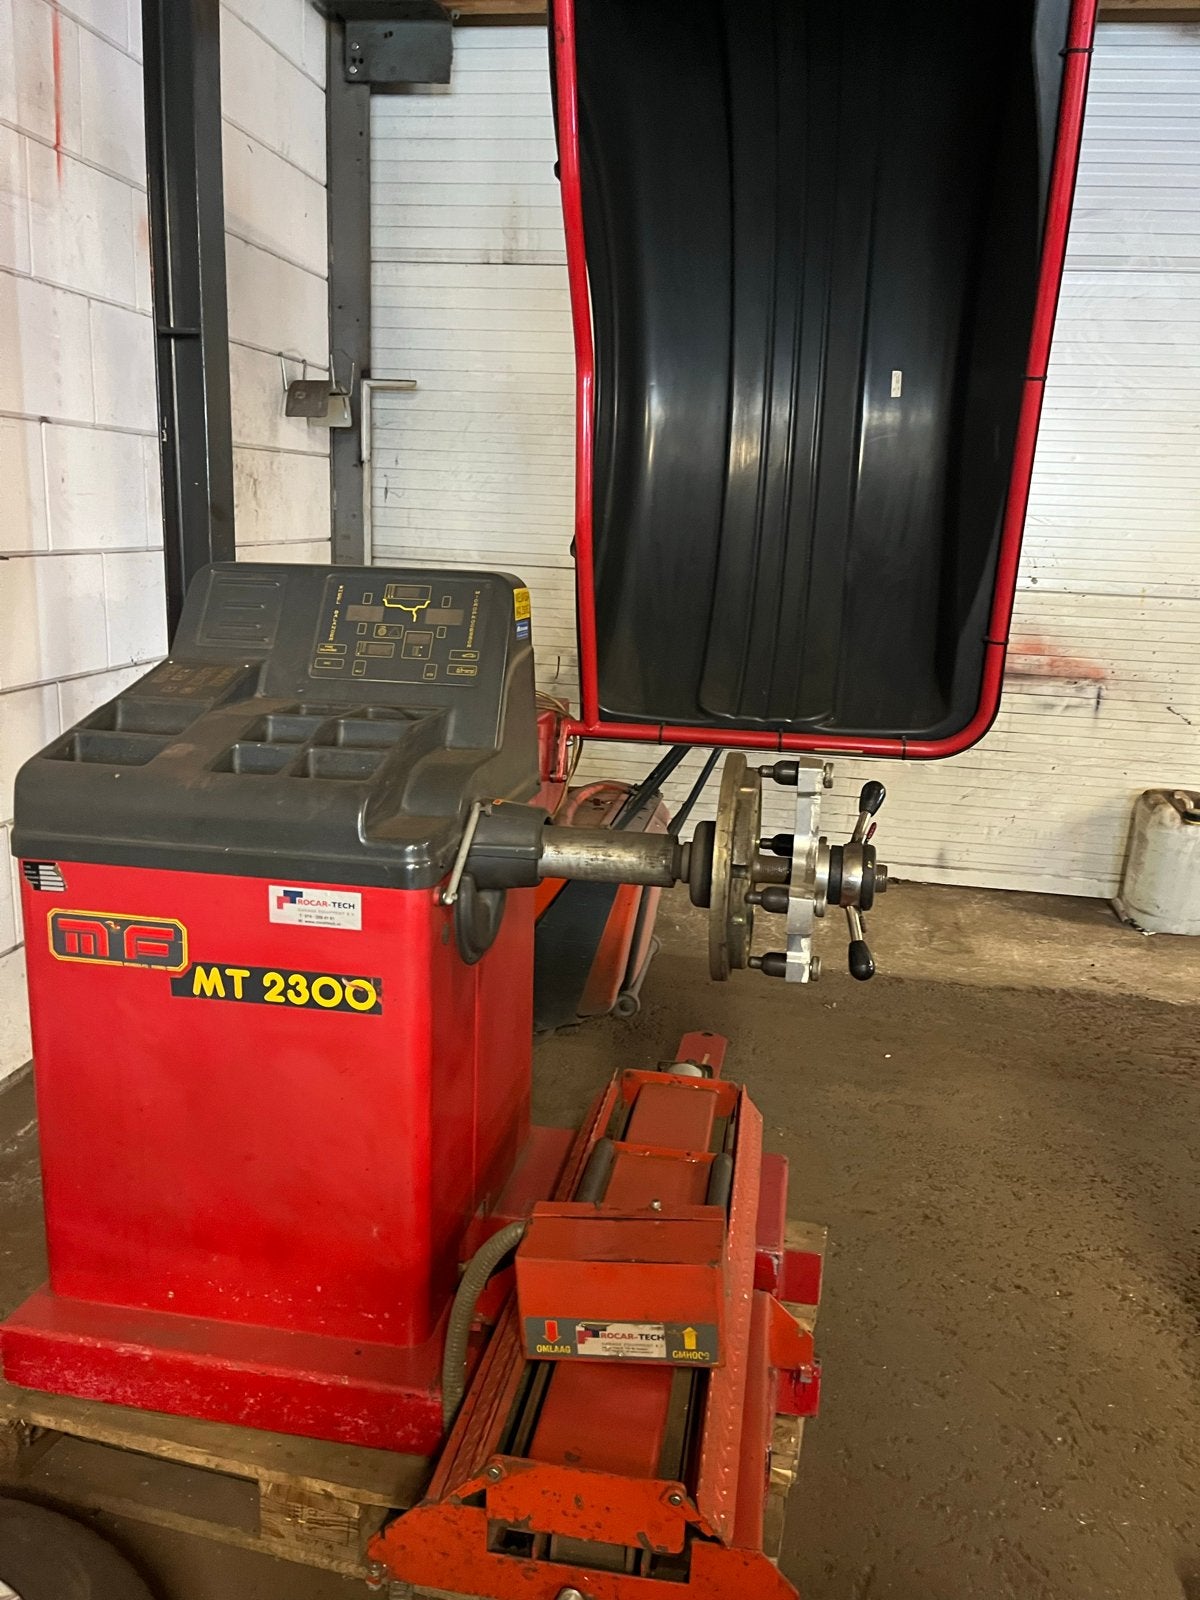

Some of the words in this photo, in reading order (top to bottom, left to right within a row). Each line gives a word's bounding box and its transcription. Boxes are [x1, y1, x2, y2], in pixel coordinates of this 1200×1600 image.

[297, 898, 356, 910] ROCAR-TECH
[193, 965, 250, 998] MT
[263, 971, 377, 1011] 2300
[600, 1332, 665, 1341] ROCAR-TECH
